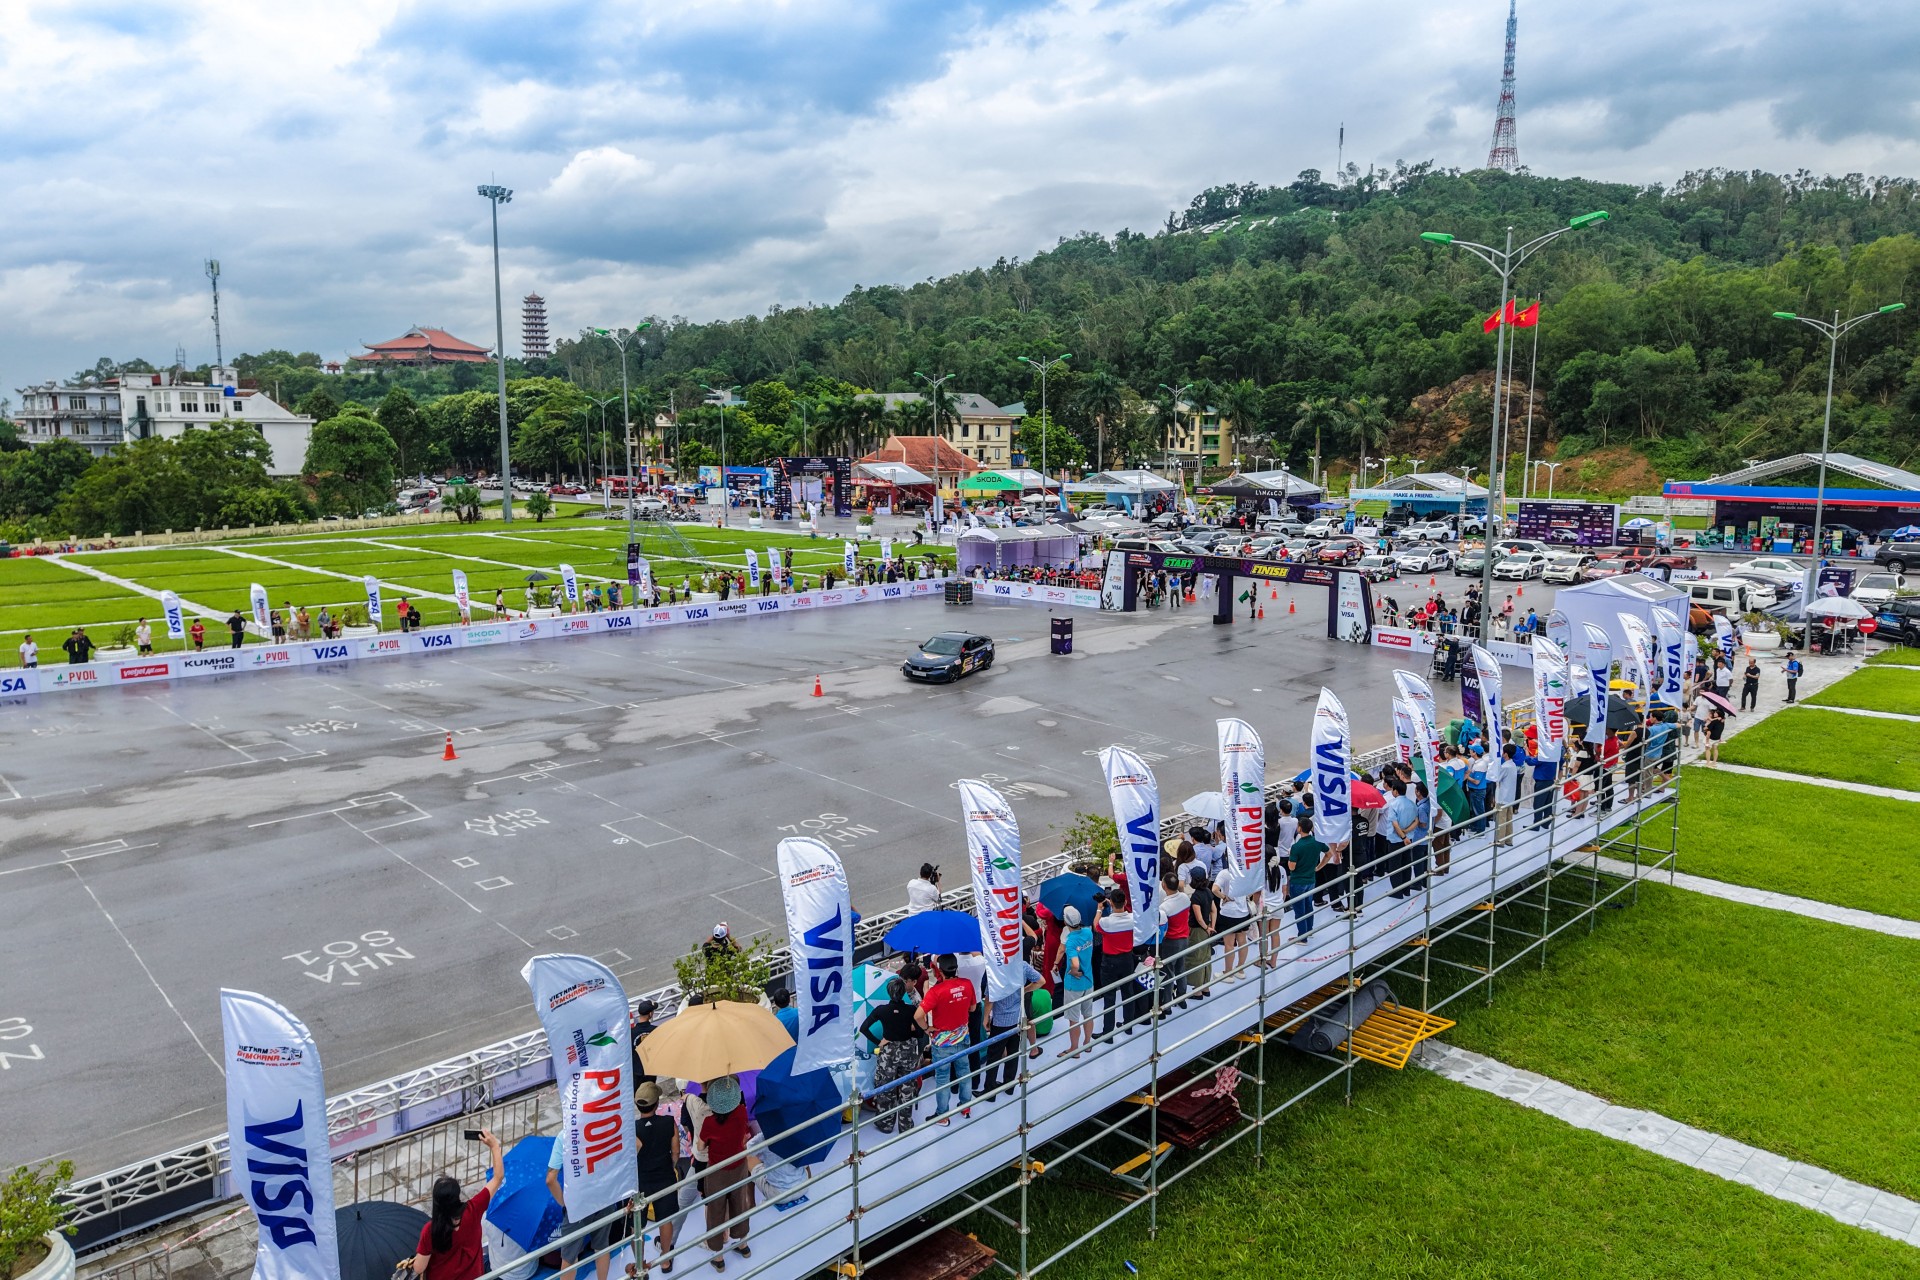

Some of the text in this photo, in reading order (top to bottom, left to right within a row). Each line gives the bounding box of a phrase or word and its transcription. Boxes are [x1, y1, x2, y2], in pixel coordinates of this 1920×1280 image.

[750, 561, 758, 582] VISA
[1163, 558, 1194, 569] START
[1251, 564, 1289, 577] FINISH
[566, 576, 576, 600] VISA
[883, 587, 901, 597] VISA
[994, 584, 1011, 595] VISA
[368, 591, 381, 615] VISA
[718, 604, 747, 612] KUMHO
[757, 600, 779, 611] VISA
[167, 606, 181, 633] VISA
[605, 616, 632, 628] VISA
[685, 608, 708, 619] VISA
[467, 629, 502, 639] SKODA
[571, 620, 589, 630] PVOIL
[379, 640, 400, 649] PVOIL
[420, 635, 452, 648] VISA
[265, 651, 290, 662] PVOIL
[312, 645, 348, 660] VISA
[185, 656, 235, 669] KUMHO
[1665, 642, 1682, 693] VISA
[69, 670, 98, 681] PVOIL
[1591, 662, 1608, 724] VISA
[1316, 734, 1348, 817] VISA
[1238, 806, 1263, 870] PVOIL
[982, 845, 994, 886] PETROVIETNAM
[1126, 804, 1159, 913] VISA
[988, 918, 994, 929] xa
[992, 885, 1020, 965] PVOIL
[803, 902, 844, 1037] VISA
[549, 984, 577, 1002] VIETNAM
[565, 1044, 574, 1064] PVOIL
[572, 1028, 589, 1067] PETROVIETNAM
[569, 1072, 581, 1178] Đường xa thêm gần
[582, 1068, 624, 1175] PVOIL
[244, 1098, 317, 1250] VISA
